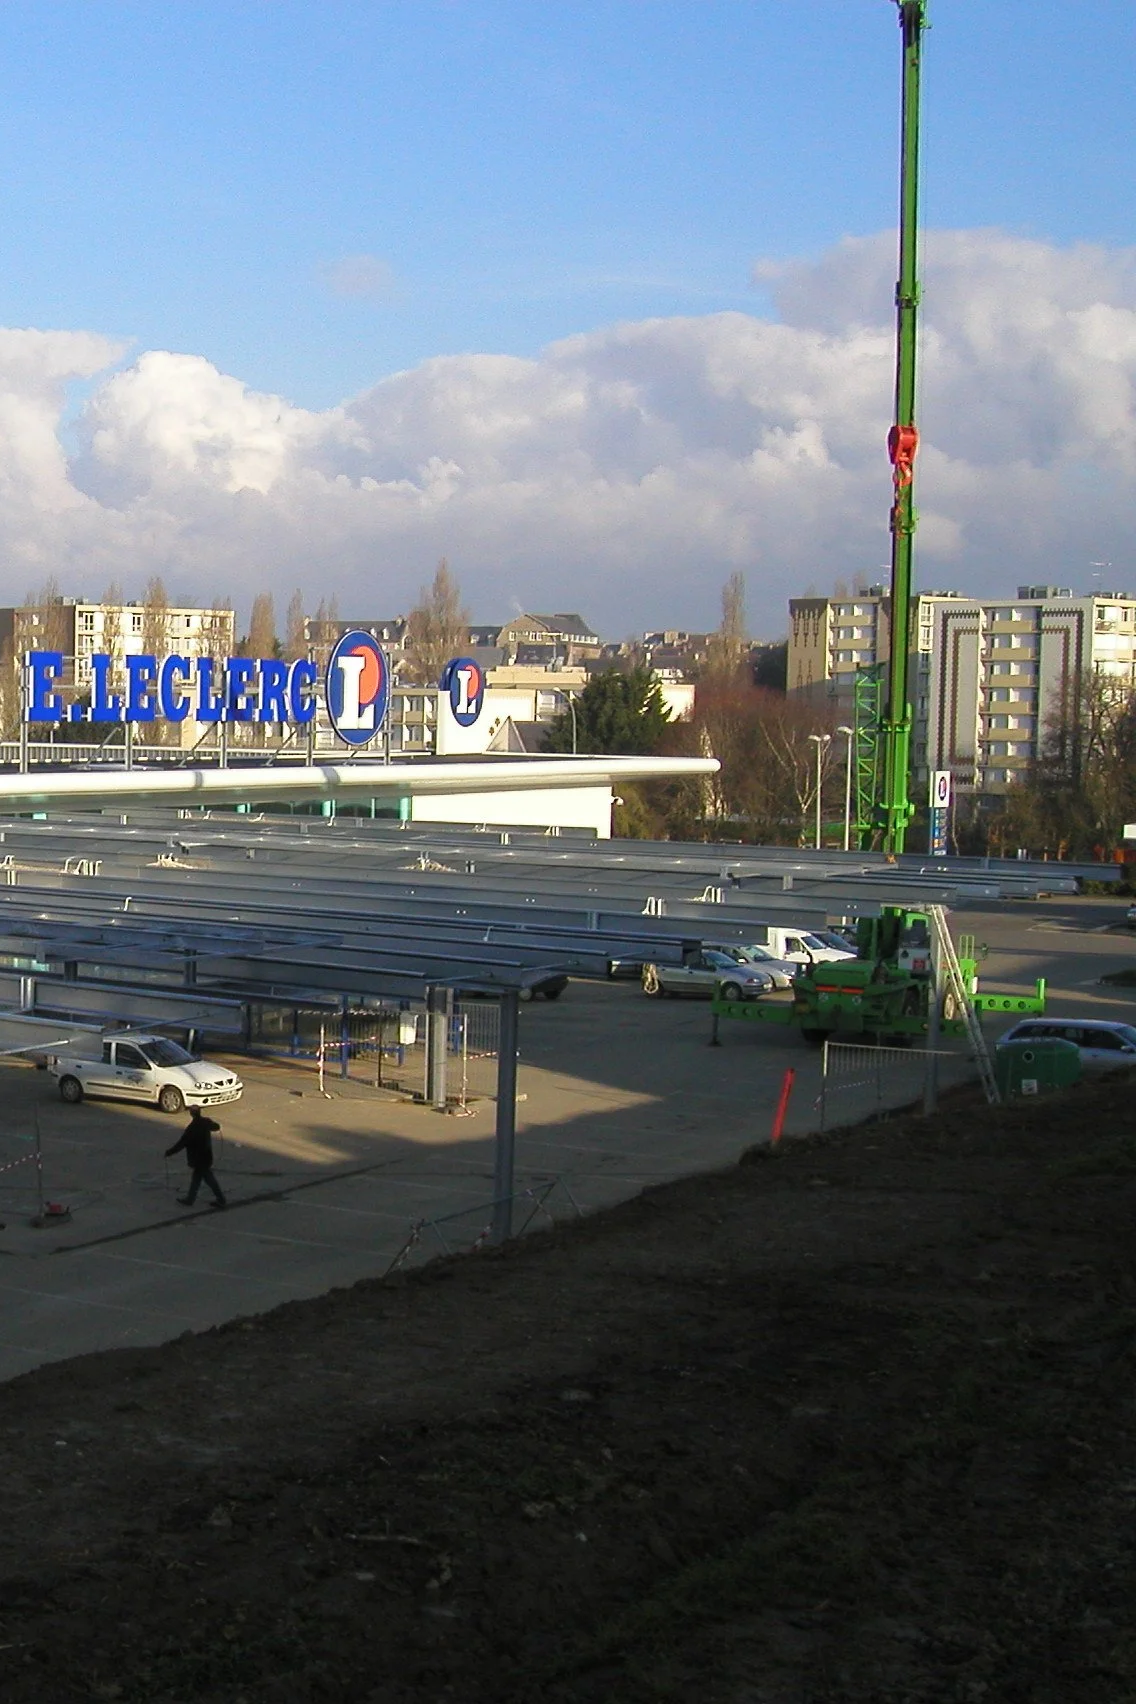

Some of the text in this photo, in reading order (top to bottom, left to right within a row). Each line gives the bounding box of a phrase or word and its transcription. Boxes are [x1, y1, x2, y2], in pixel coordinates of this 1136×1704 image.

[24, 650, 317, 723] E.LECLERC
[337, 656, 375, 730] L
[457, 670, 477, 714] L
